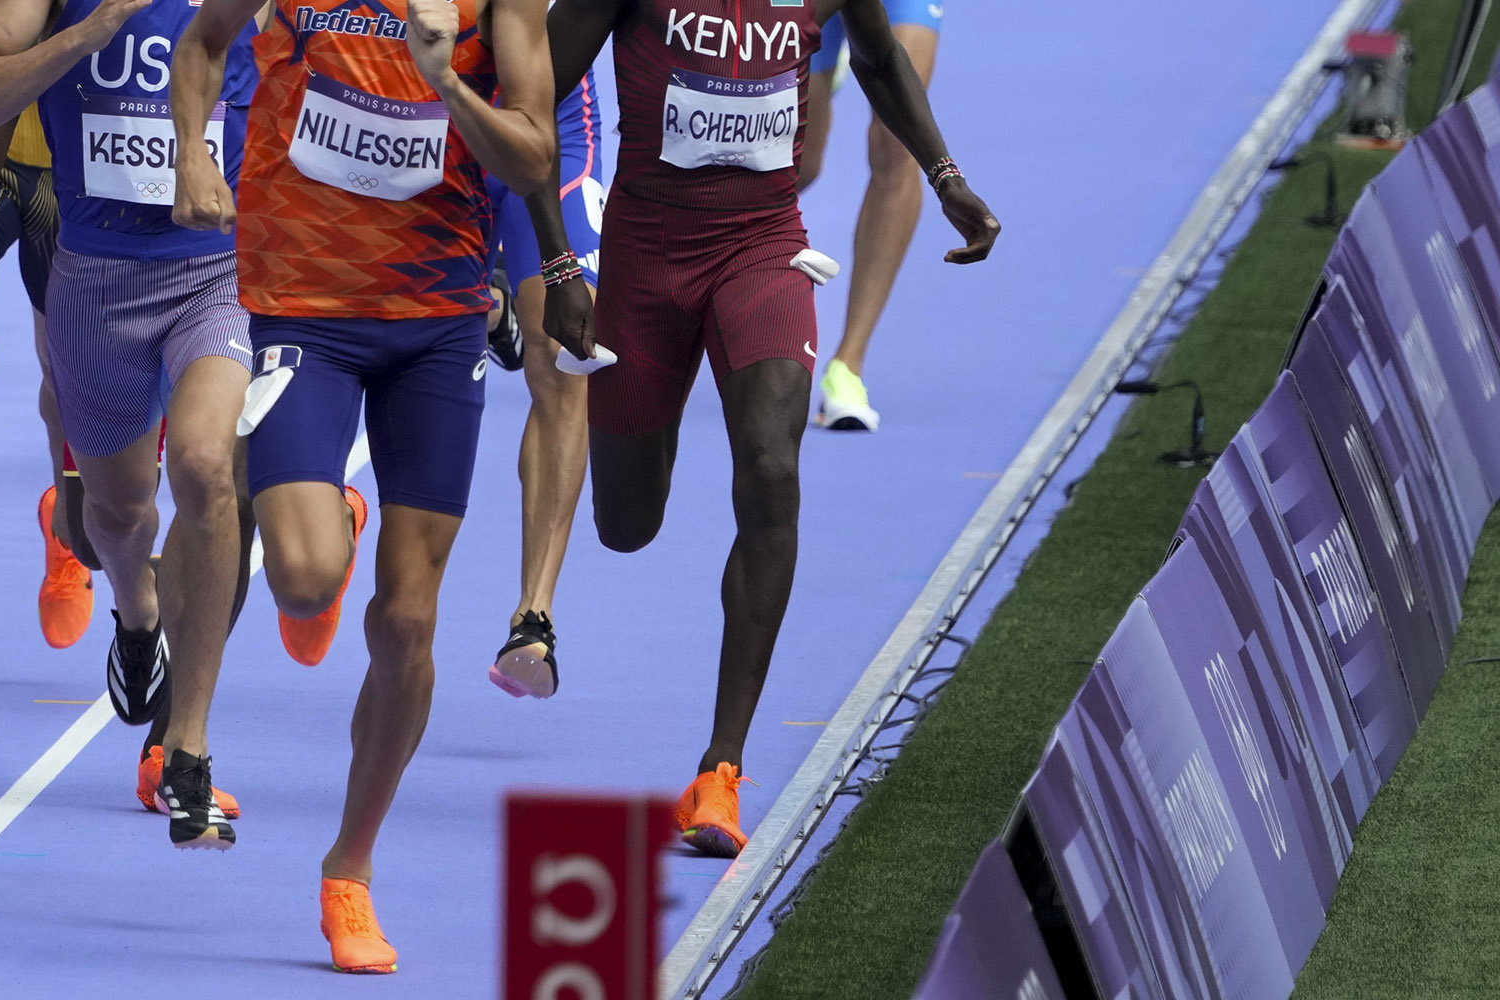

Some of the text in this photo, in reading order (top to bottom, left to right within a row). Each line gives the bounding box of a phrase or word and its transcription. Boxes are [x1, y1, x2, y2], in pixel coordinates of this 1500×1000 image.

[296, 6, 407, 41] nederla
[665, 8, 800, 62] KENYA
[90, 33, 172, 93] US
[344, 89, 417, 116] PARIS 2024
[707, 80, 775, 93] PARIS 2024
[120, 102, 157, 114] PARIS
[666, 103, 795, 143] R. CHERUIYOT
[297, 107, 443, 170] NILLESSEN
